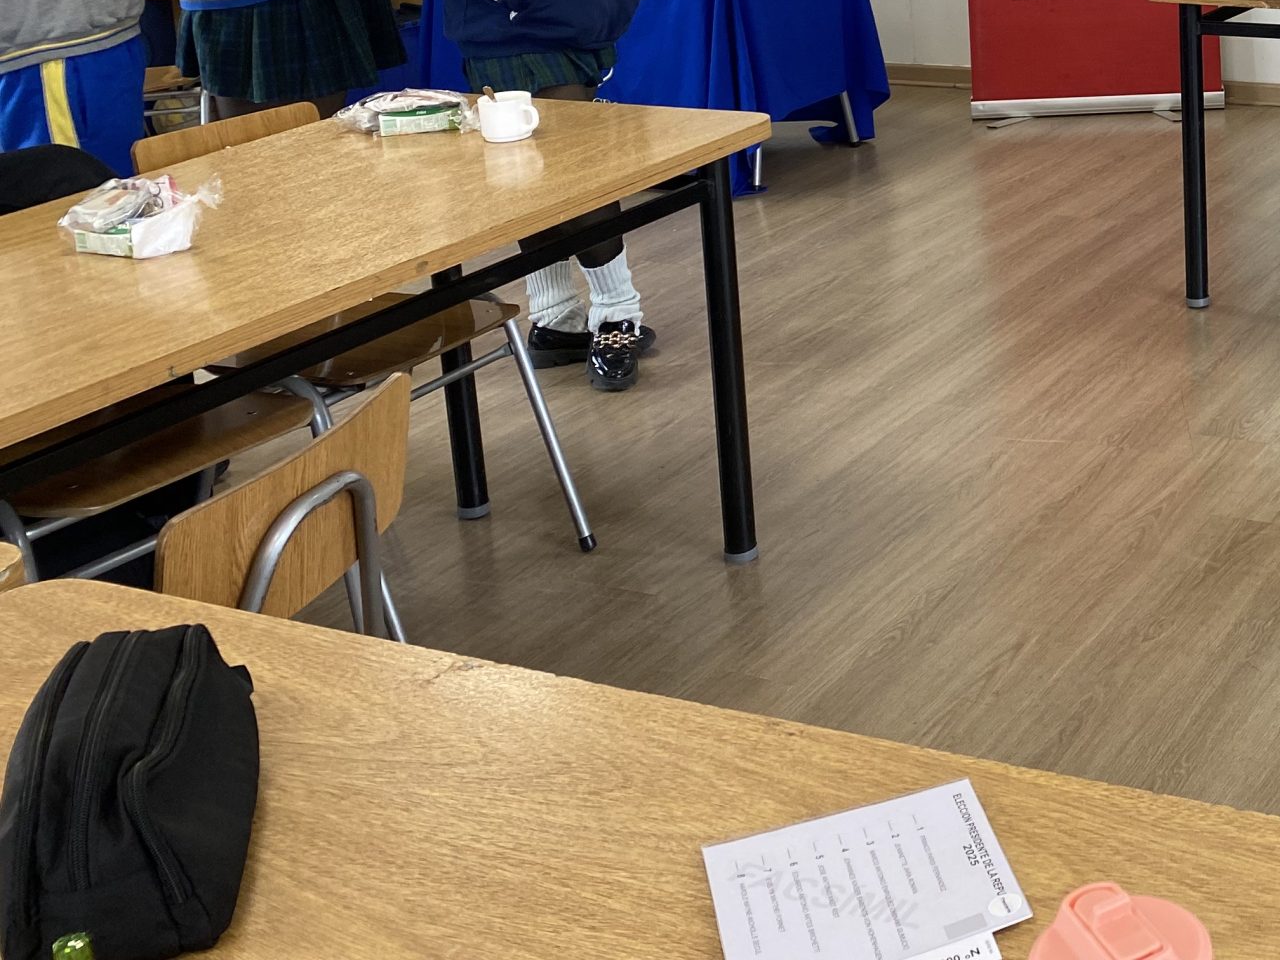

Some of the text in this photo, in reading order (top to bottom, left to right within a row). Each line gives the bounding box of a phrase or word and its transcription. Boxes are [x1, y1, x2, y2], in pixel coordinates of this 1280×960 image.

[952, 793, 973, 823] ELECCION
[967, 822, 989, 859] PRESIDENTE
[962, 843, 979, 866] 2025
[982, 858, 994, 868] DE
[986, 867, 998, 878] LA
